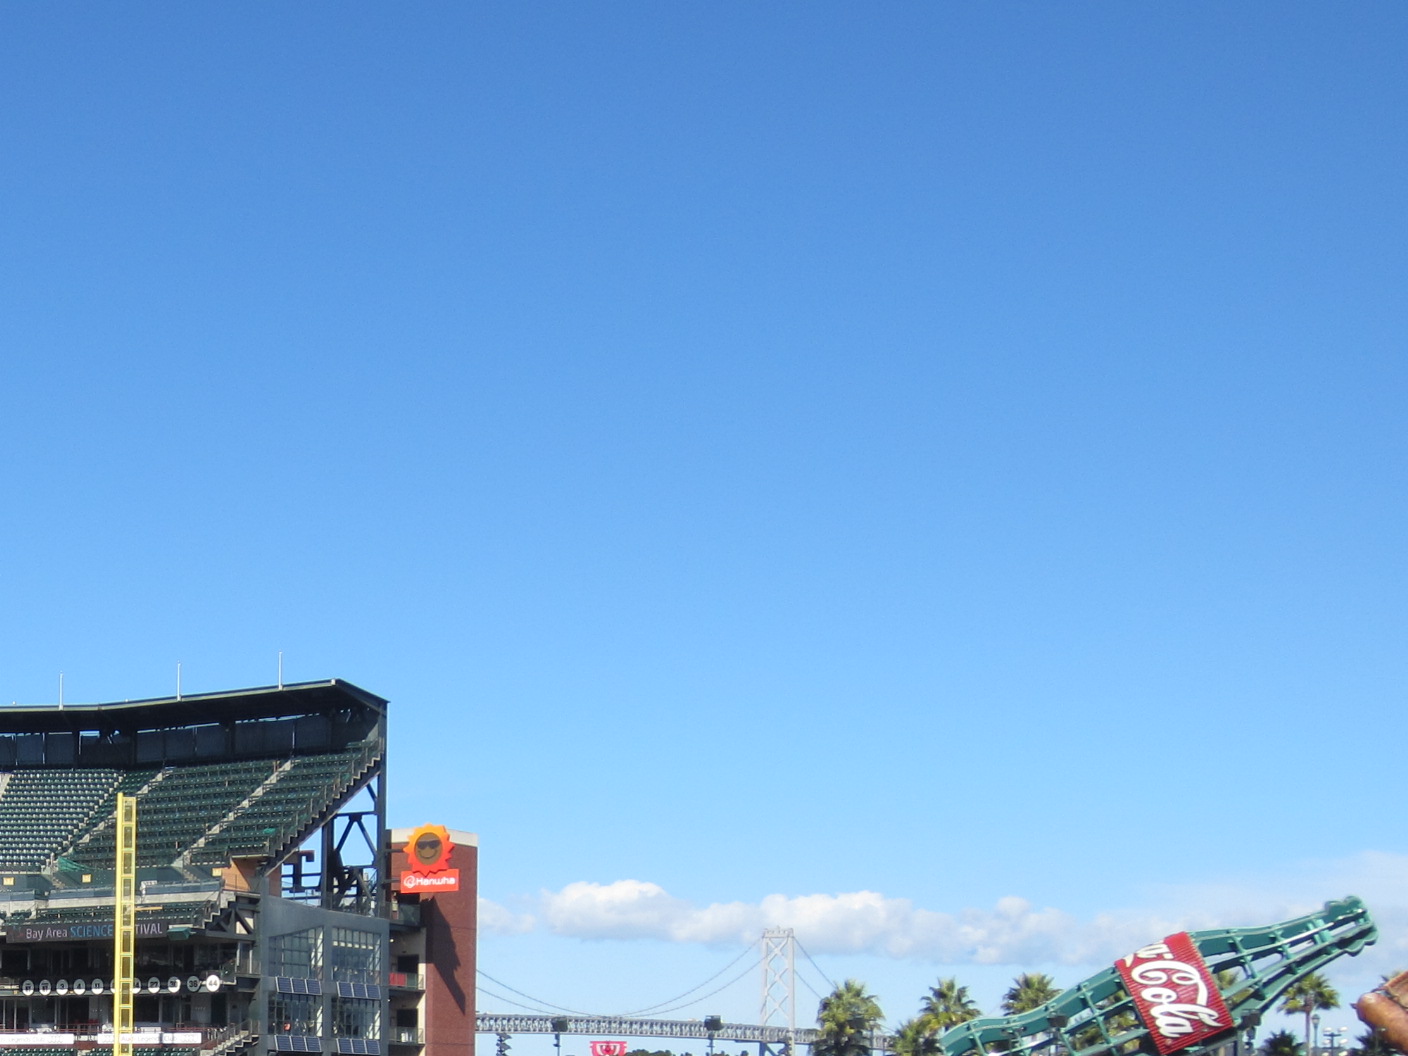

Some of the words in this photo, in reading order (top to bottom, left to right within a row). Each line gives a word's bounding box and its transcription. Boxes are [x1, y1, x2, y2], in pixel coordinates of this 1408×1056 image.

[415, 877, 456, 886] Hanwha
[26, 928, 44, 941] Bay
[46, 927, 68, 938] Area
[70, 925, 114, 938] SCIENCE
[135, 923, 163, 935] TIVAL
